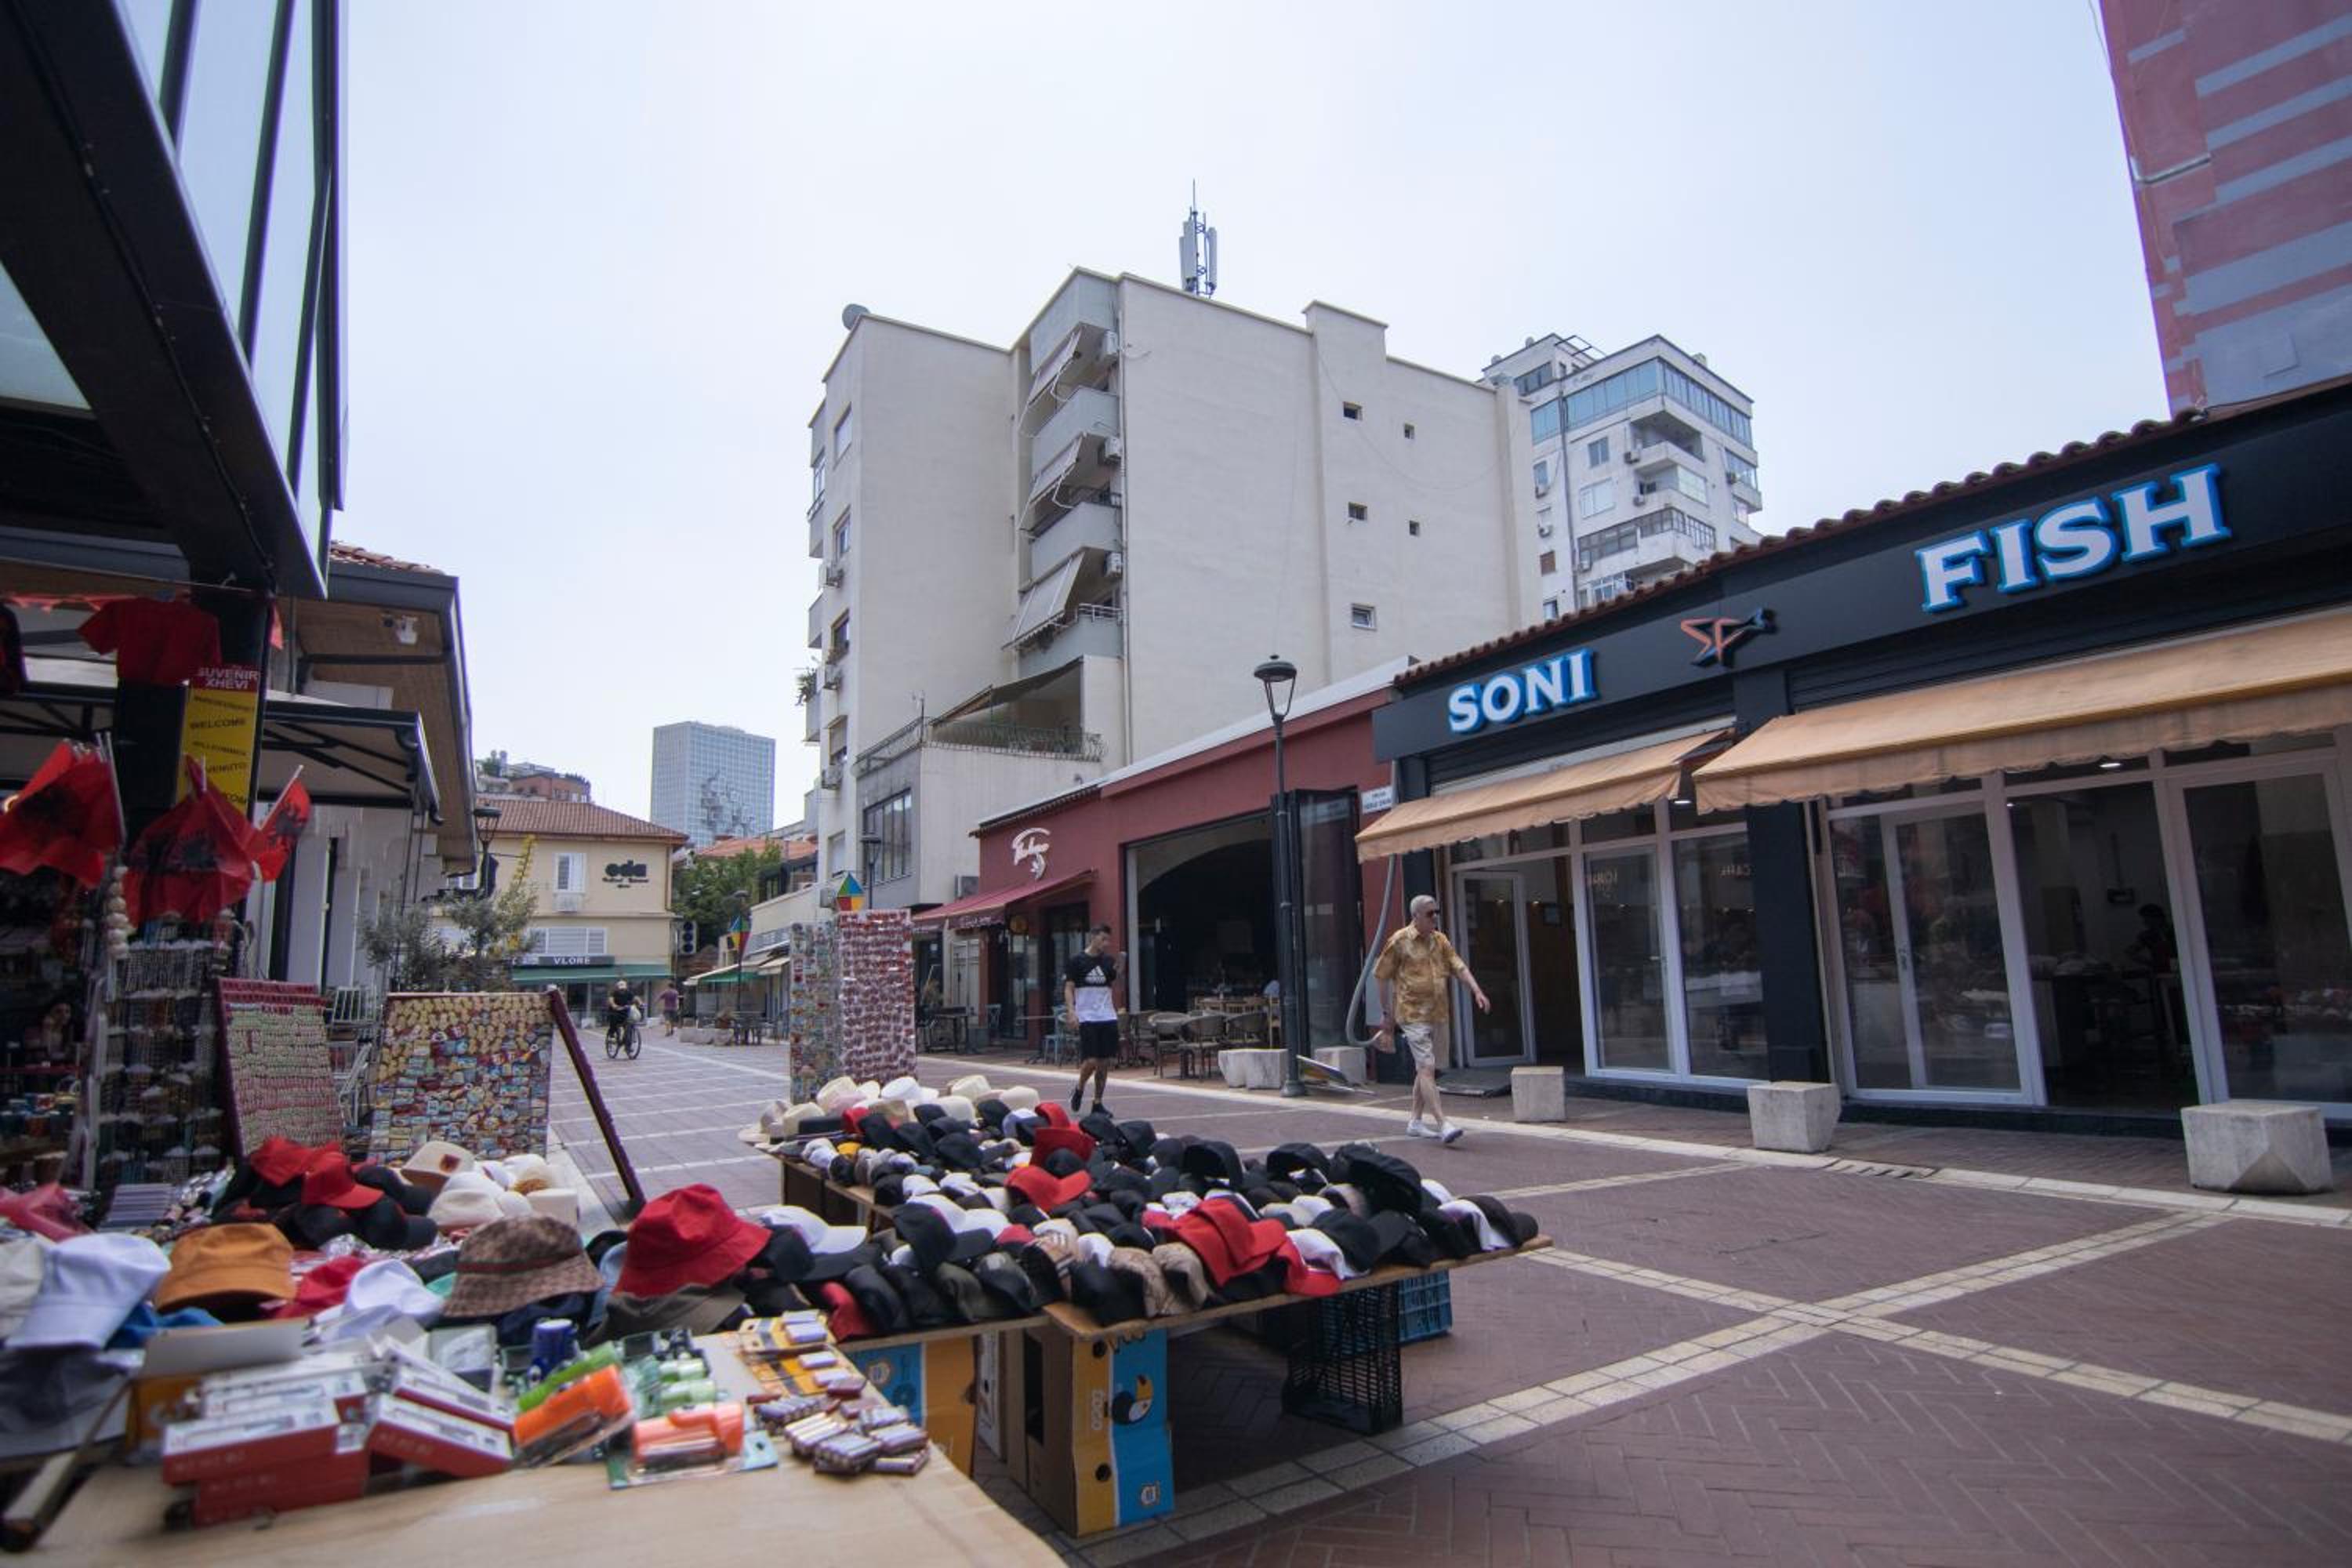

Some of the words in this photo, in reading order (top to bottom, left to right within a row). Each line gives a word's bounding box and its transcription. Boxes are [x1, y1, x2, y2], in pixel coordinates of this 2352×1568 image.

[1448, 647, 1597, 734] SONI
[1915, 462, 2233, 613] FISH
[205, 678, 249, 690] XHEVI
